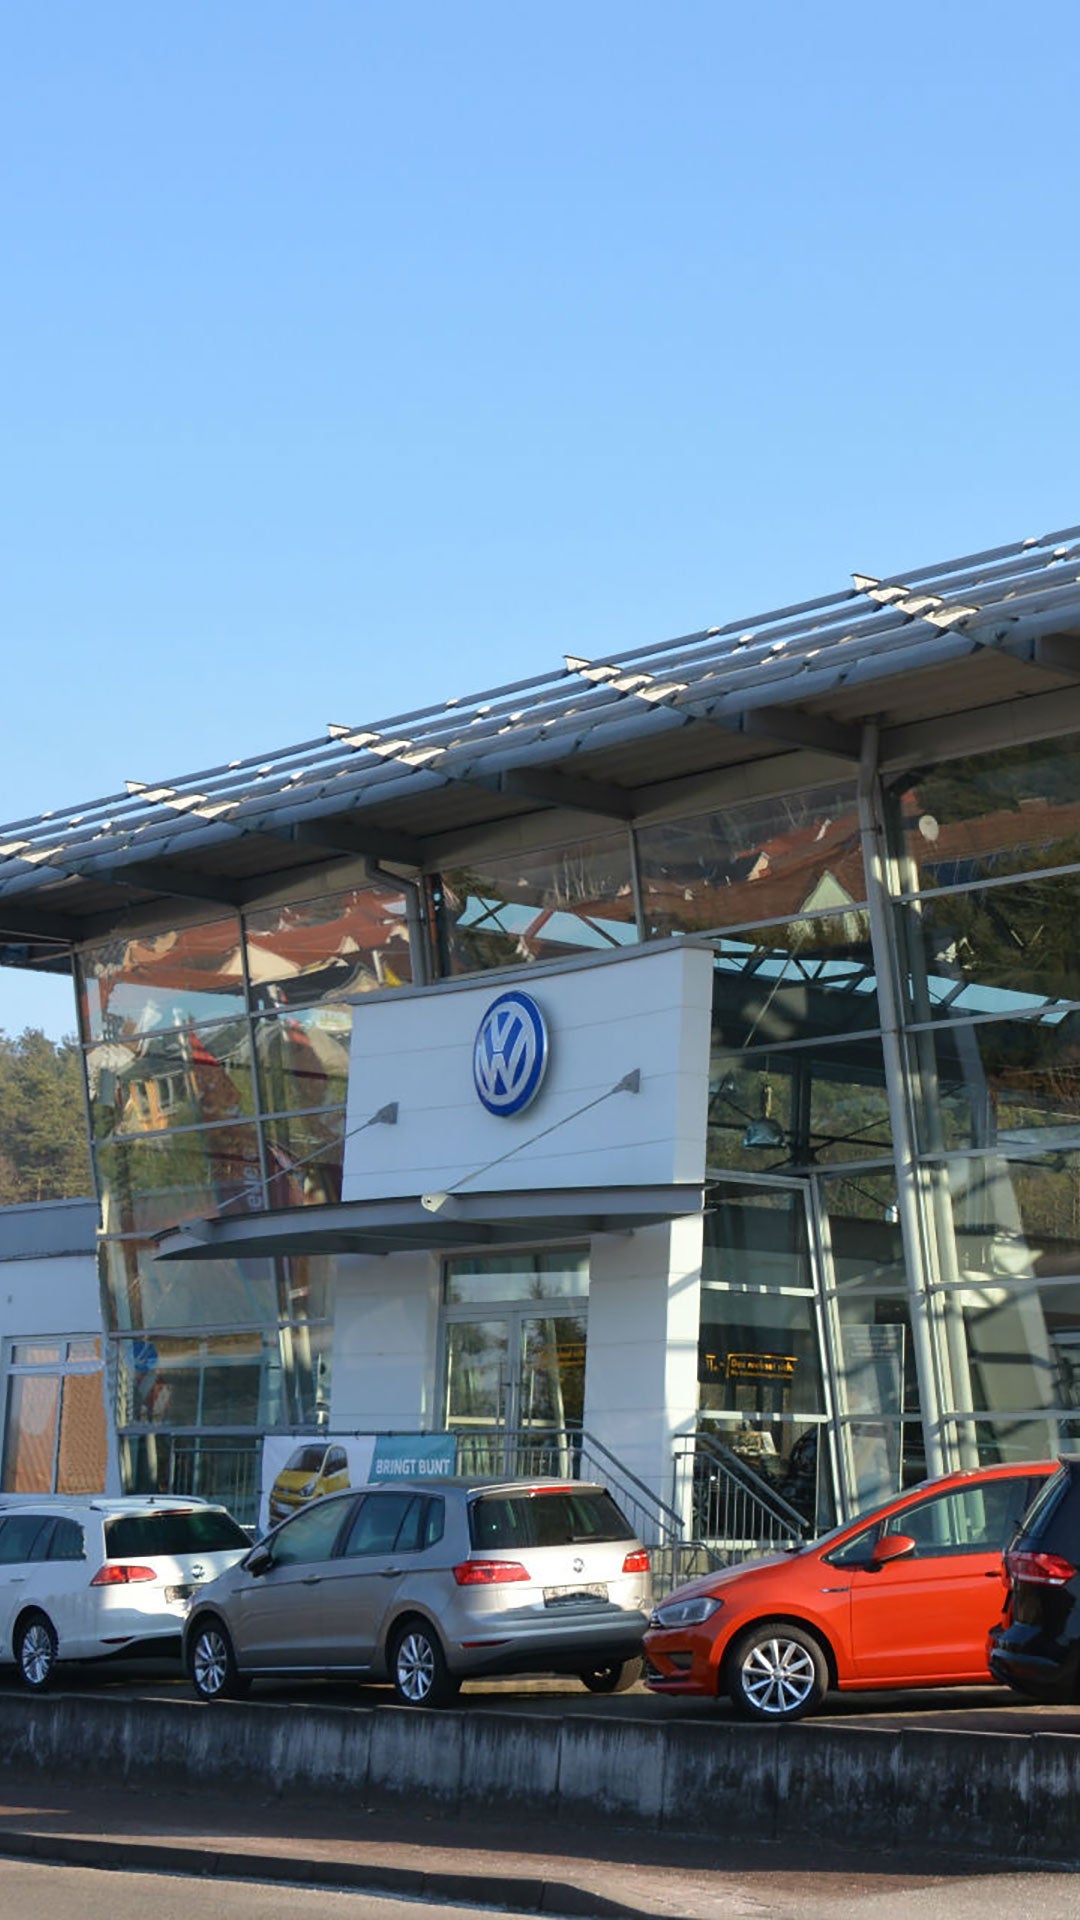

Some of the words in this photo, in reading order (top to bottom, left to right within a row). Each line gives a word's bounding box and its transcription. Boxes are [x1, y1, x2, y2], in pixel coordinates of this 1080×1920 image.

[475, 1001, 537, 1106] VW
[376, 1459, 416, 1474] BRINGT
[419, 1459, 451, 1475] BUNT
